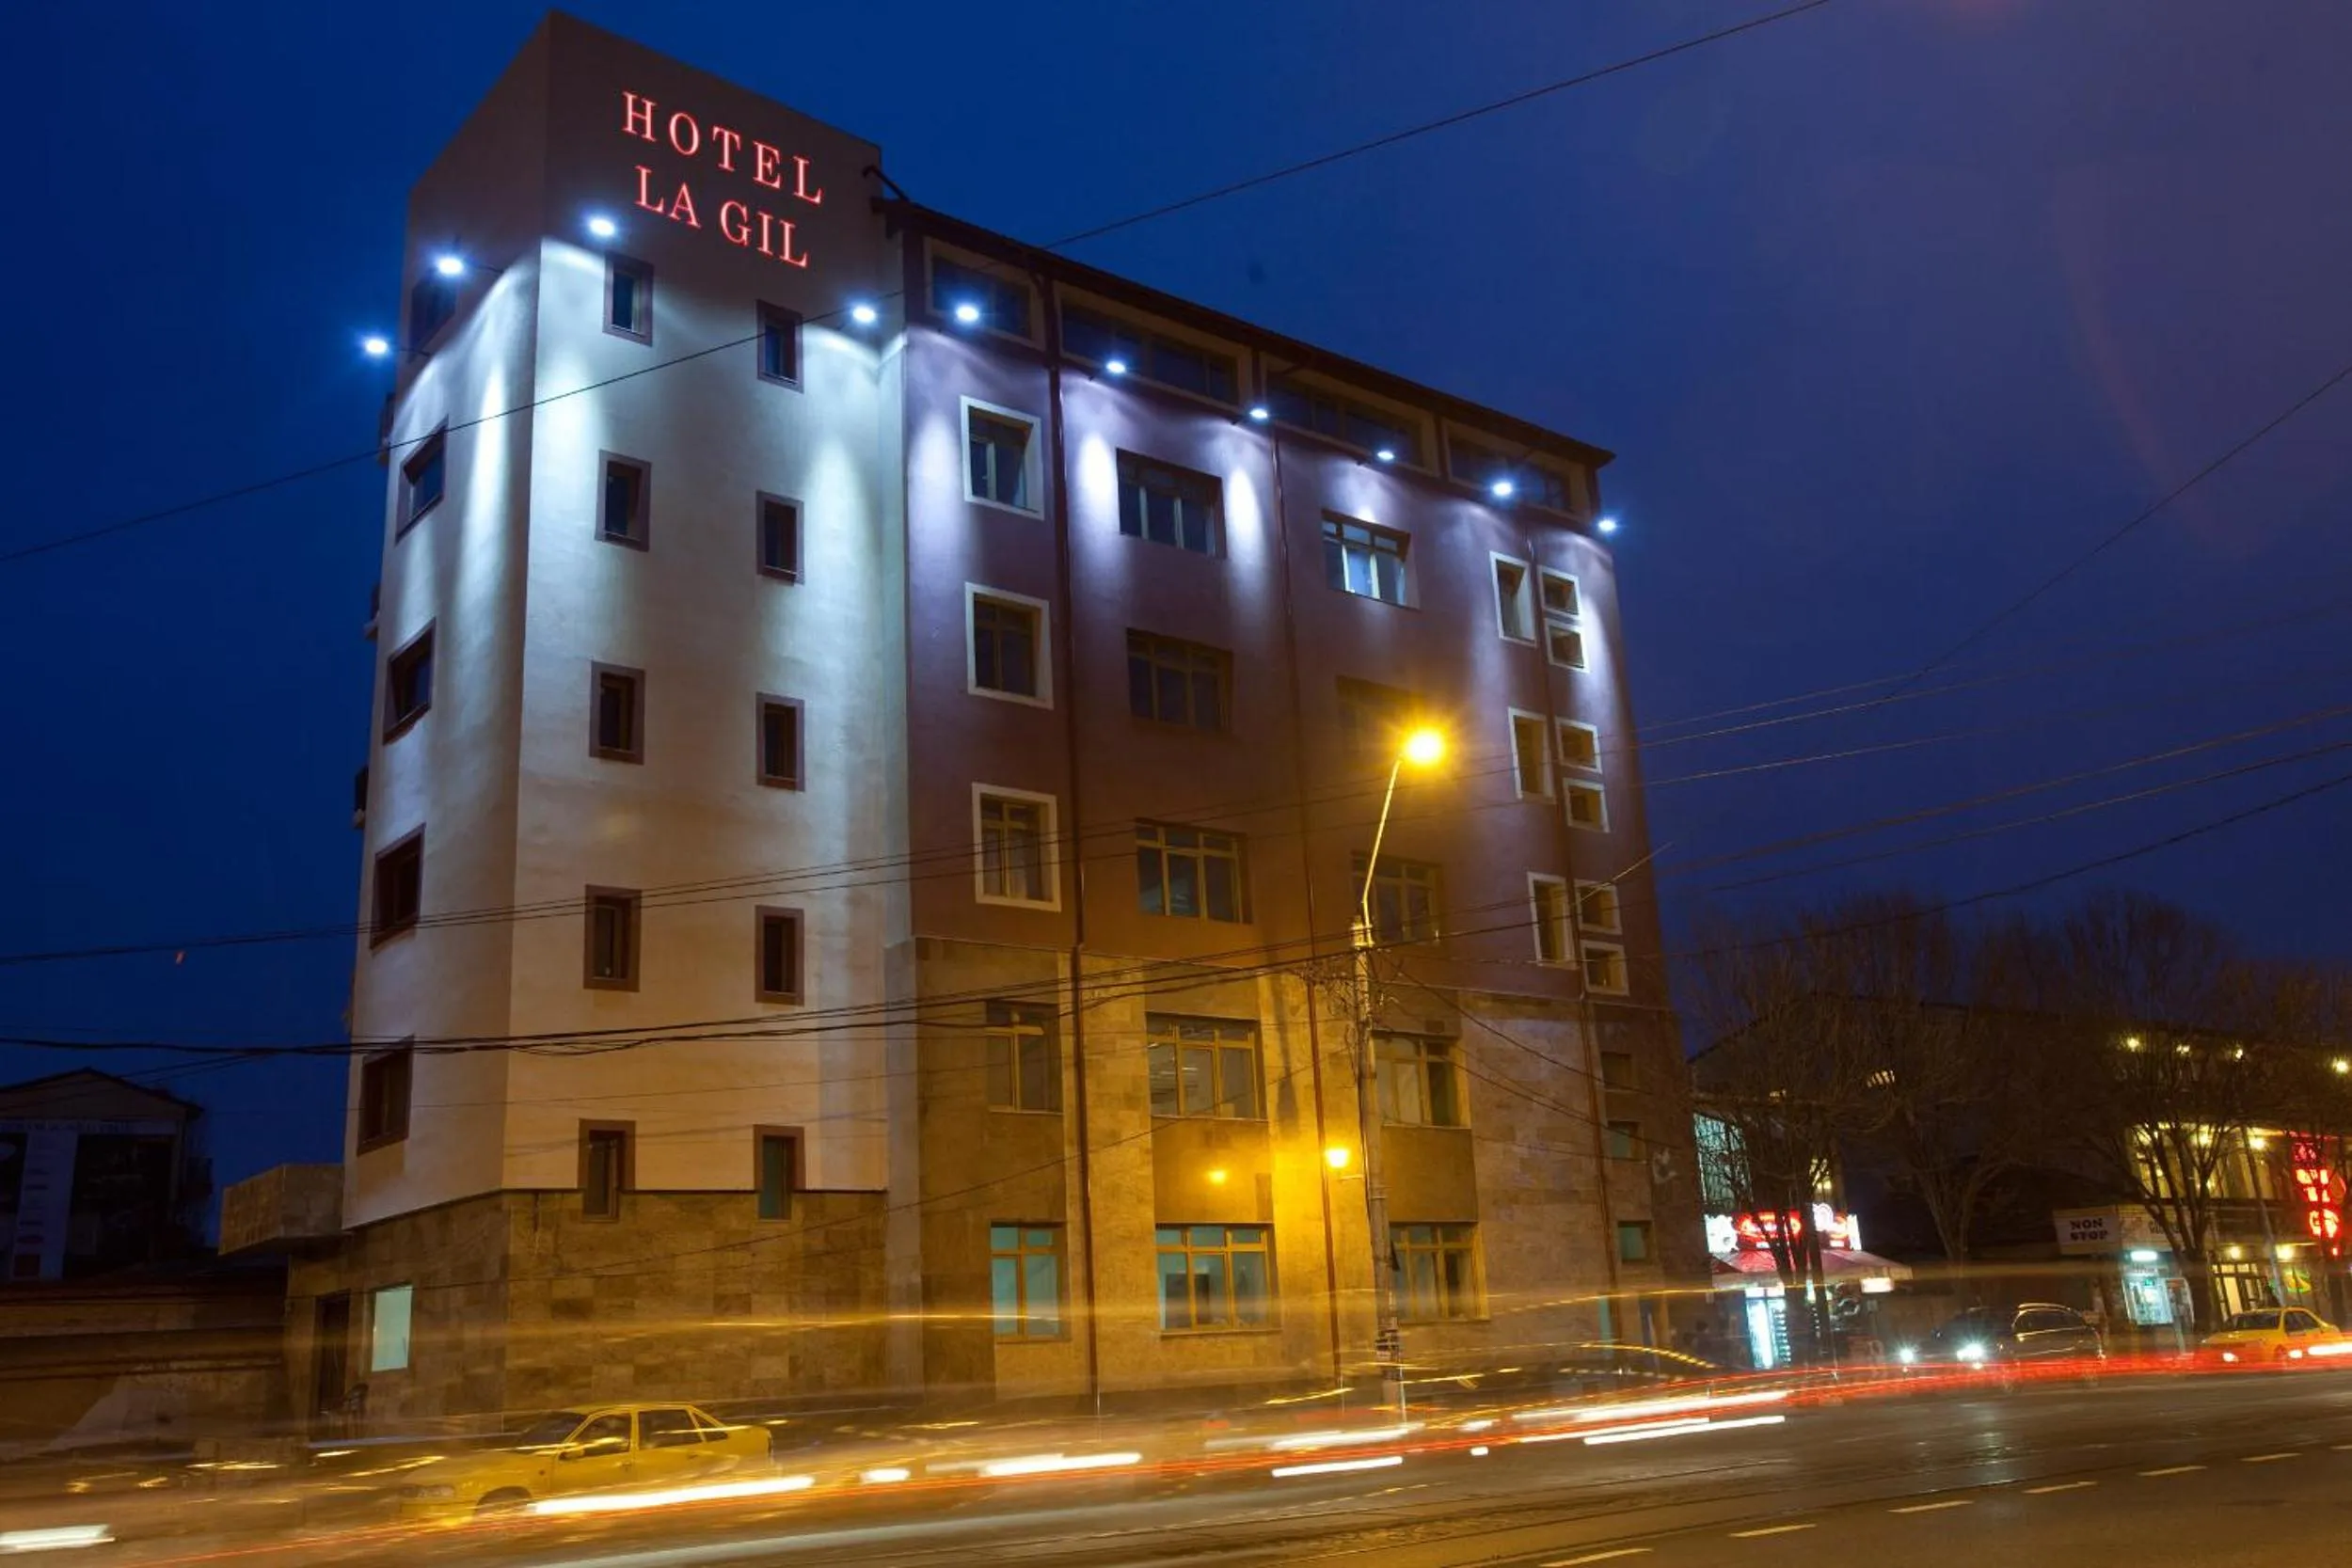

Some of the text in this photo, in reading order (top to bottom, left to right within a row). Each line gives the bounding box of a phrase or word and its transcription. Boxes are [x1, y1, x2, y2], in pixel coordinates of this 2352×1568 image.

[622, 91, 823, 204] HOTEL
[634, 166, 808, 267] LA GIL
[2070, 1217, 2103, 1230] NON
[2070, 1230, 2108, 1241] STOP
